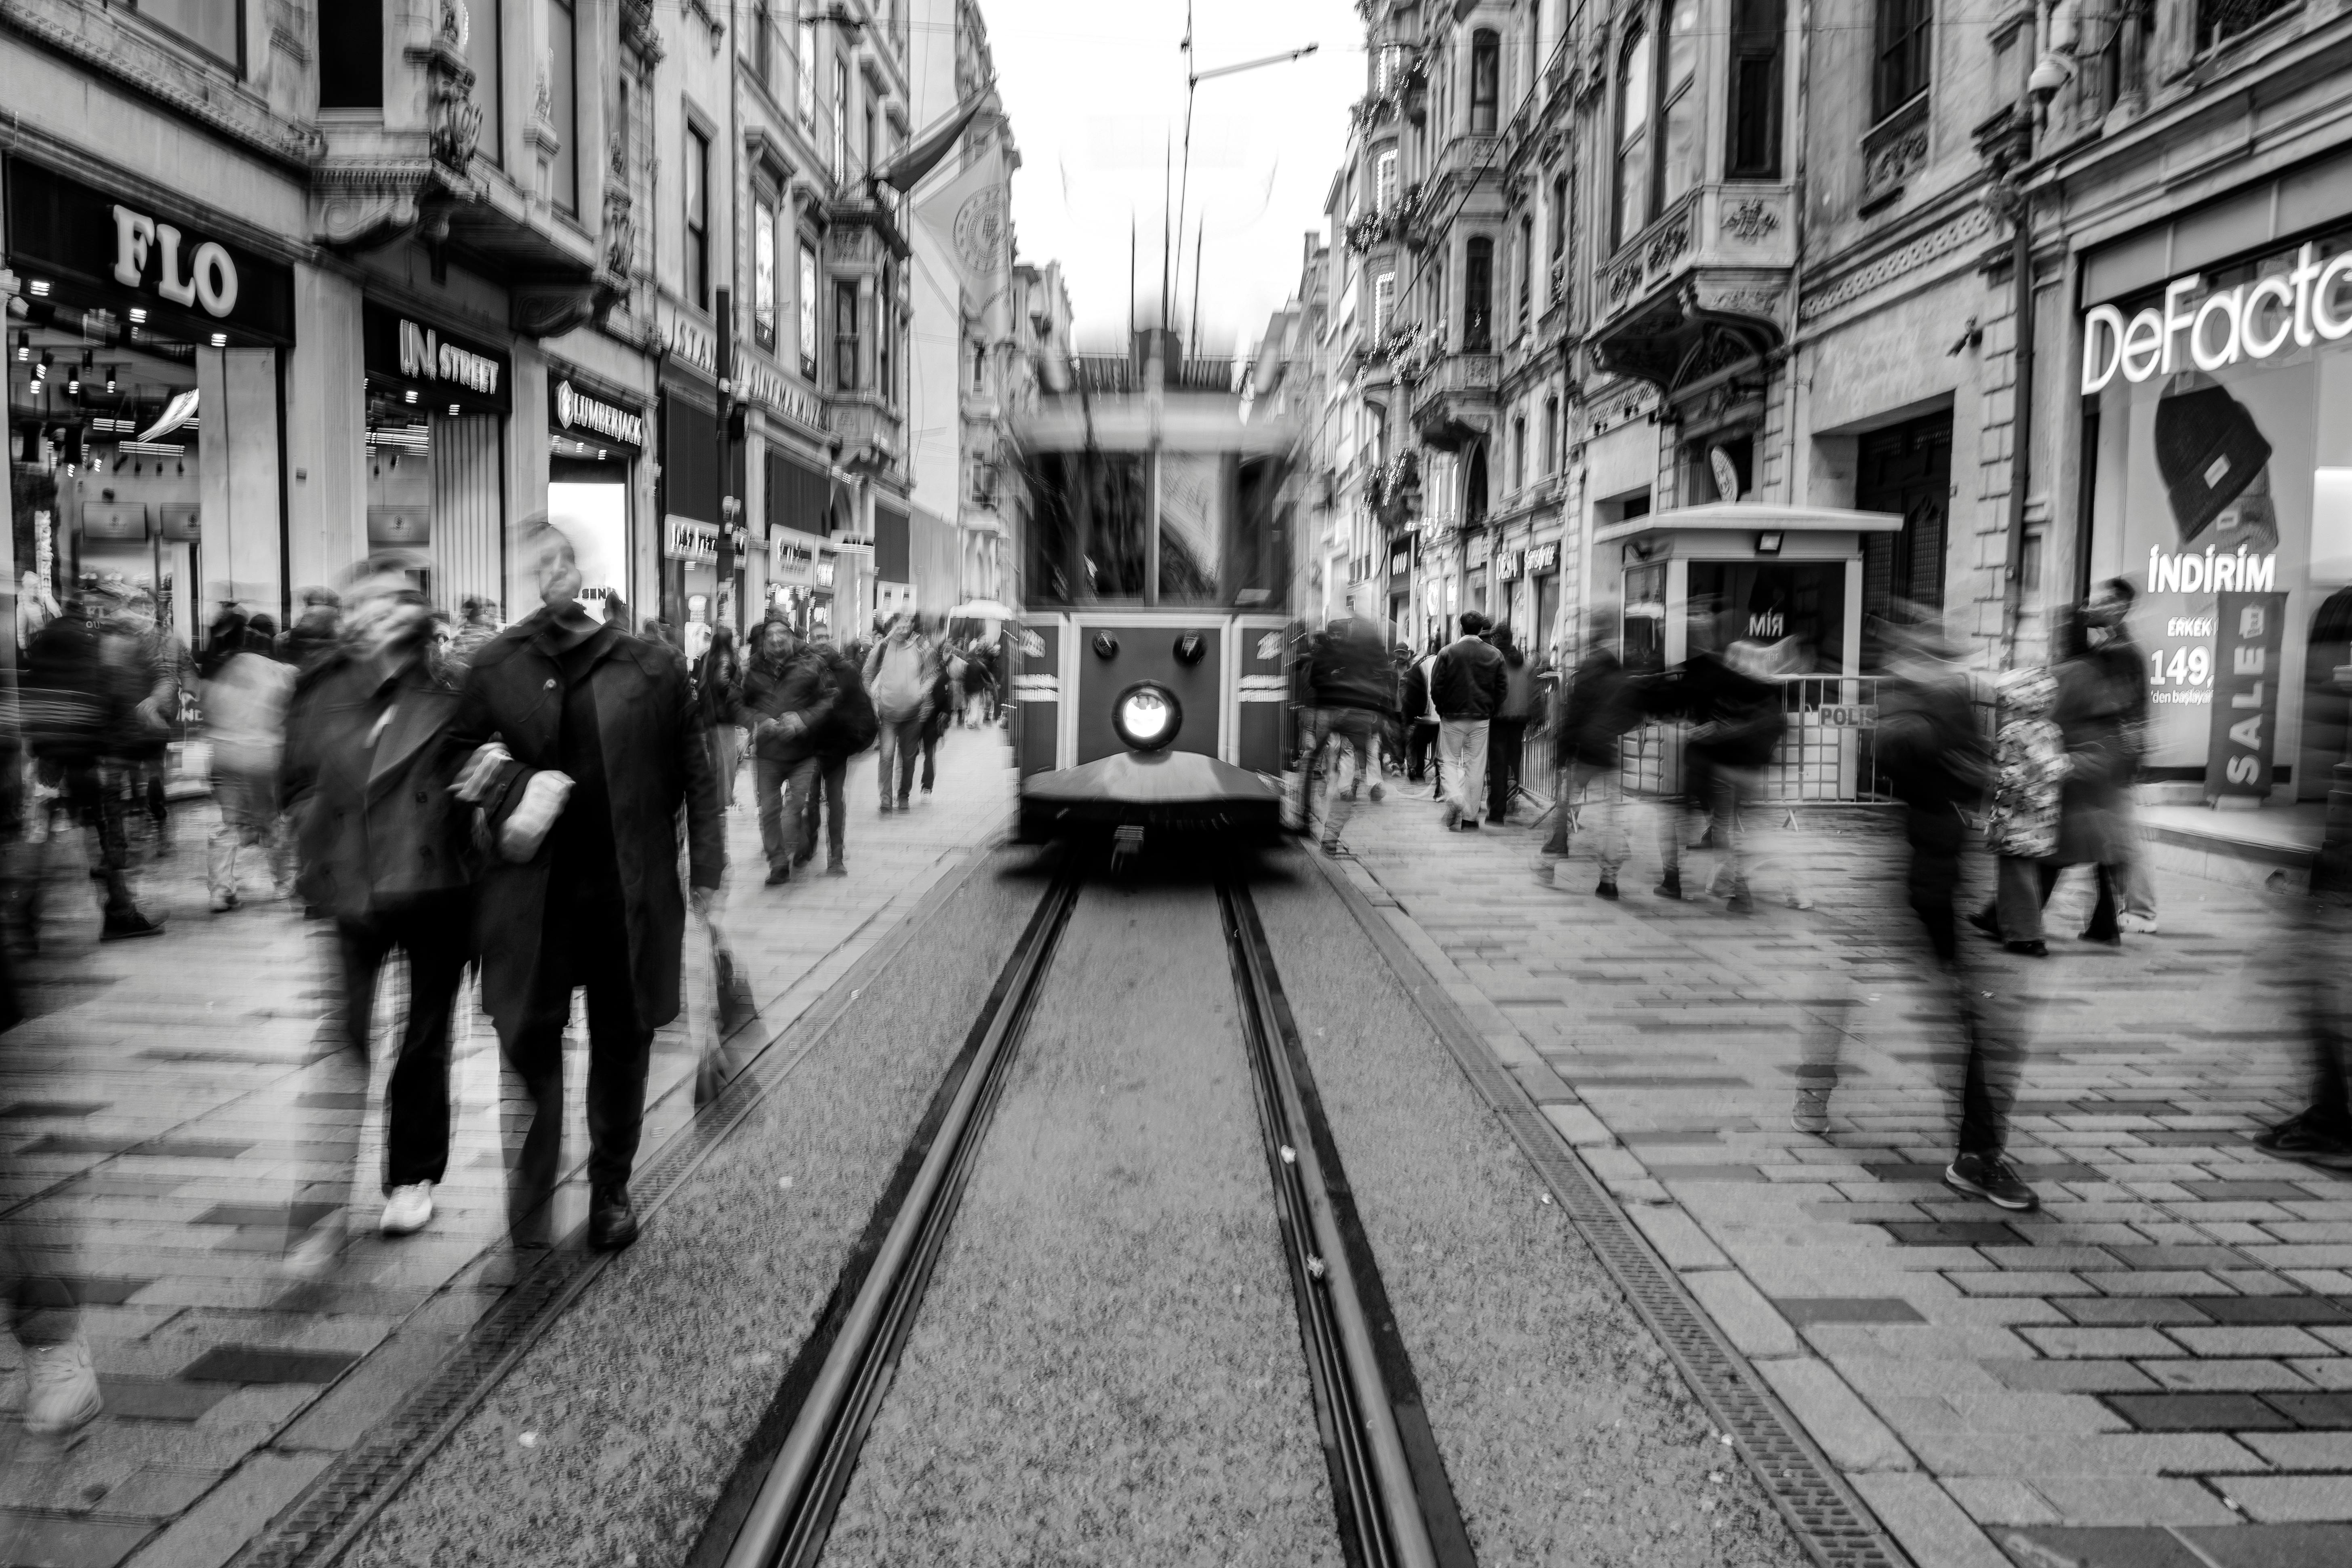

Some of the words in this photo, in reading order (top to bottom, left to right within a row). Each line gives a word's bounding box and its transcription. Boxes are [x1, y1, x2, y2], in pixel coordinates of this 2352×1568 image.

[112, 204, 238, 318] FLO
[2081, 241, 2352, 395] DeFacto
[400, 319, 437, 380] IN
[439, 343, 499, 394] STREET
[573, 393, 642, 446] LUMBERJACK
[1496, 550, 1518, 579] DESA
[2147, 543, 2276, 594] İNDİRİM
[2167, 616, 2213, 637] ERKEK
[2226, 644, 2266, 785] SALE
